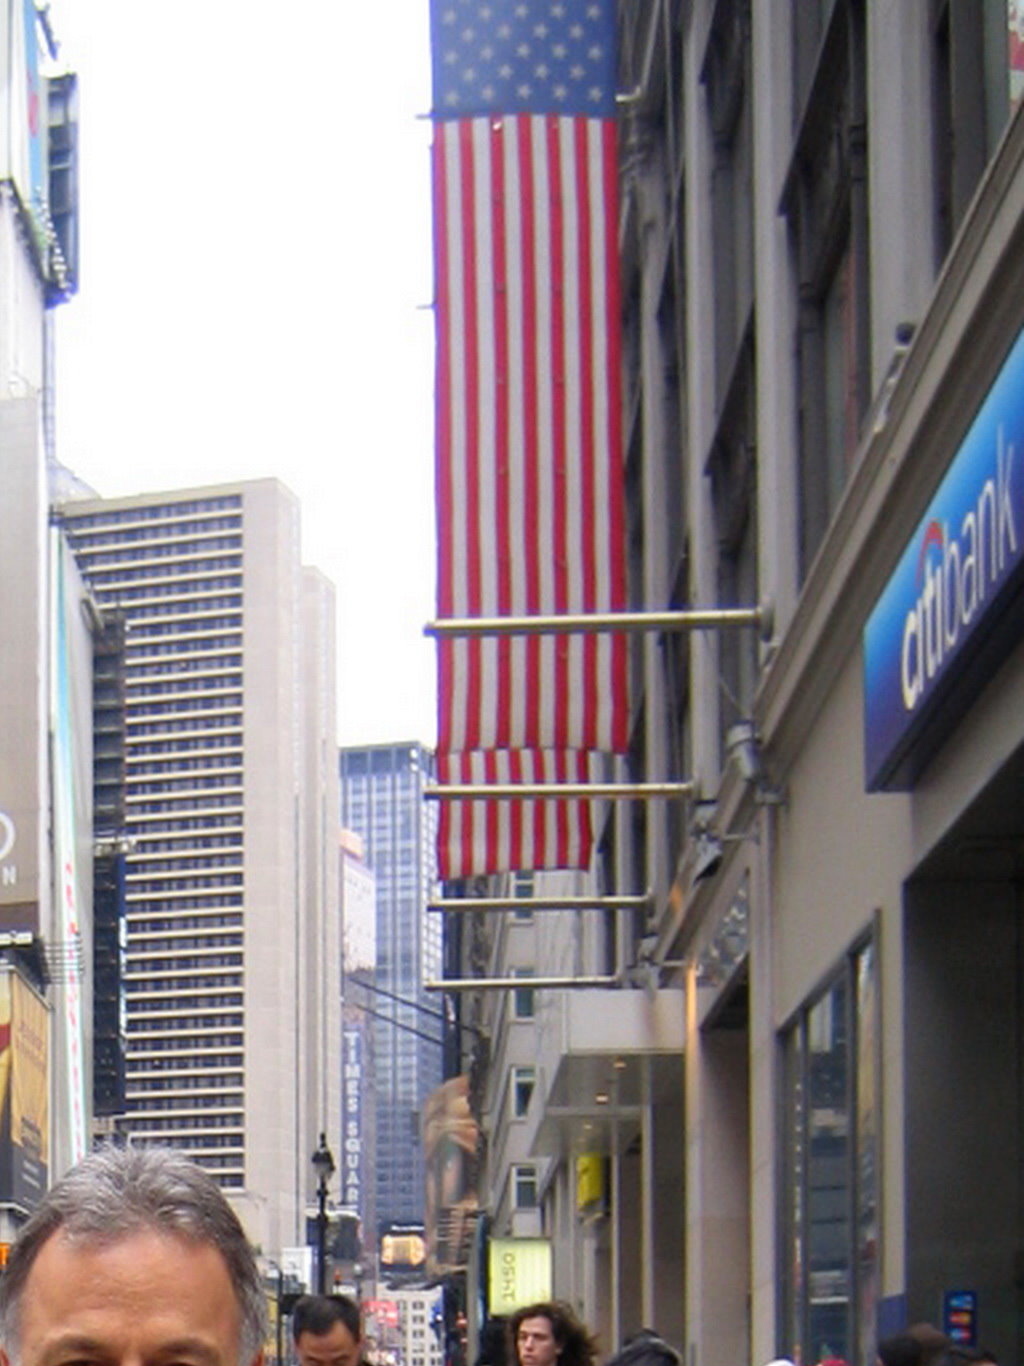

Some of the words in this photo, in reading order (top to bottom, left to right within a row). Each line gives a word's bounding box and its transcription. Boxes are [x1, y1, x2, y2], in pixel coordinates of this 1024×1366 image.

[902, 423, 1017, 709] citibank
[344, 1031, 360, 1113] TIMES
[345, 1121, 361, 1208] SQUAR
